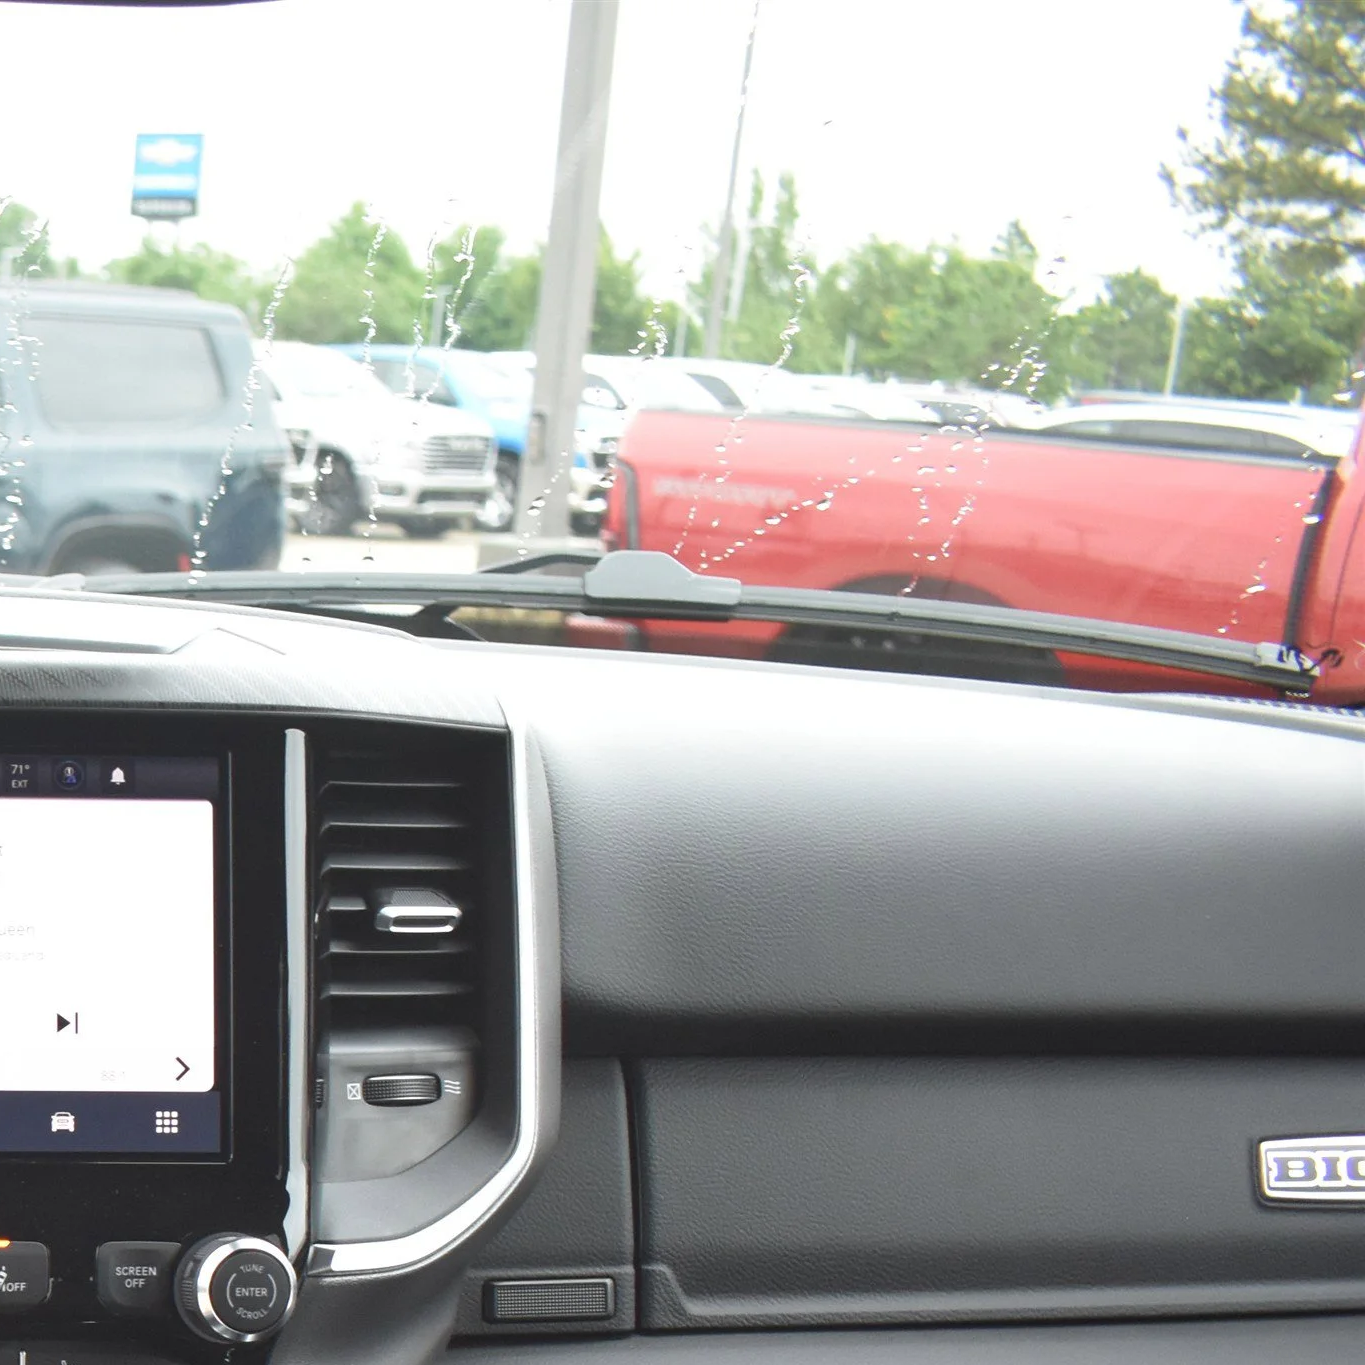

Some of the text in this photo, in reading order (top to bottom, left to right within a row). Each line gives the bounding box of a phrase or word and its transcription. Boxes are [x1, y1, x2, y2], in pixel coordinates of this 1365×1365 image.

[11, 764, 31, 775] 71°
[11, 780, 29, 789] EXT
[115, 1266, 158, 1277] SCREEN
[240, 1264, 266, 1275] TUNE
[5, 1282, 27, 1293] OFF
[125, 1278, 146, 1289] OFF
[235, 1287, 268, 1297] ENTER
[236, 1306, 268, 1320] SCROLL
